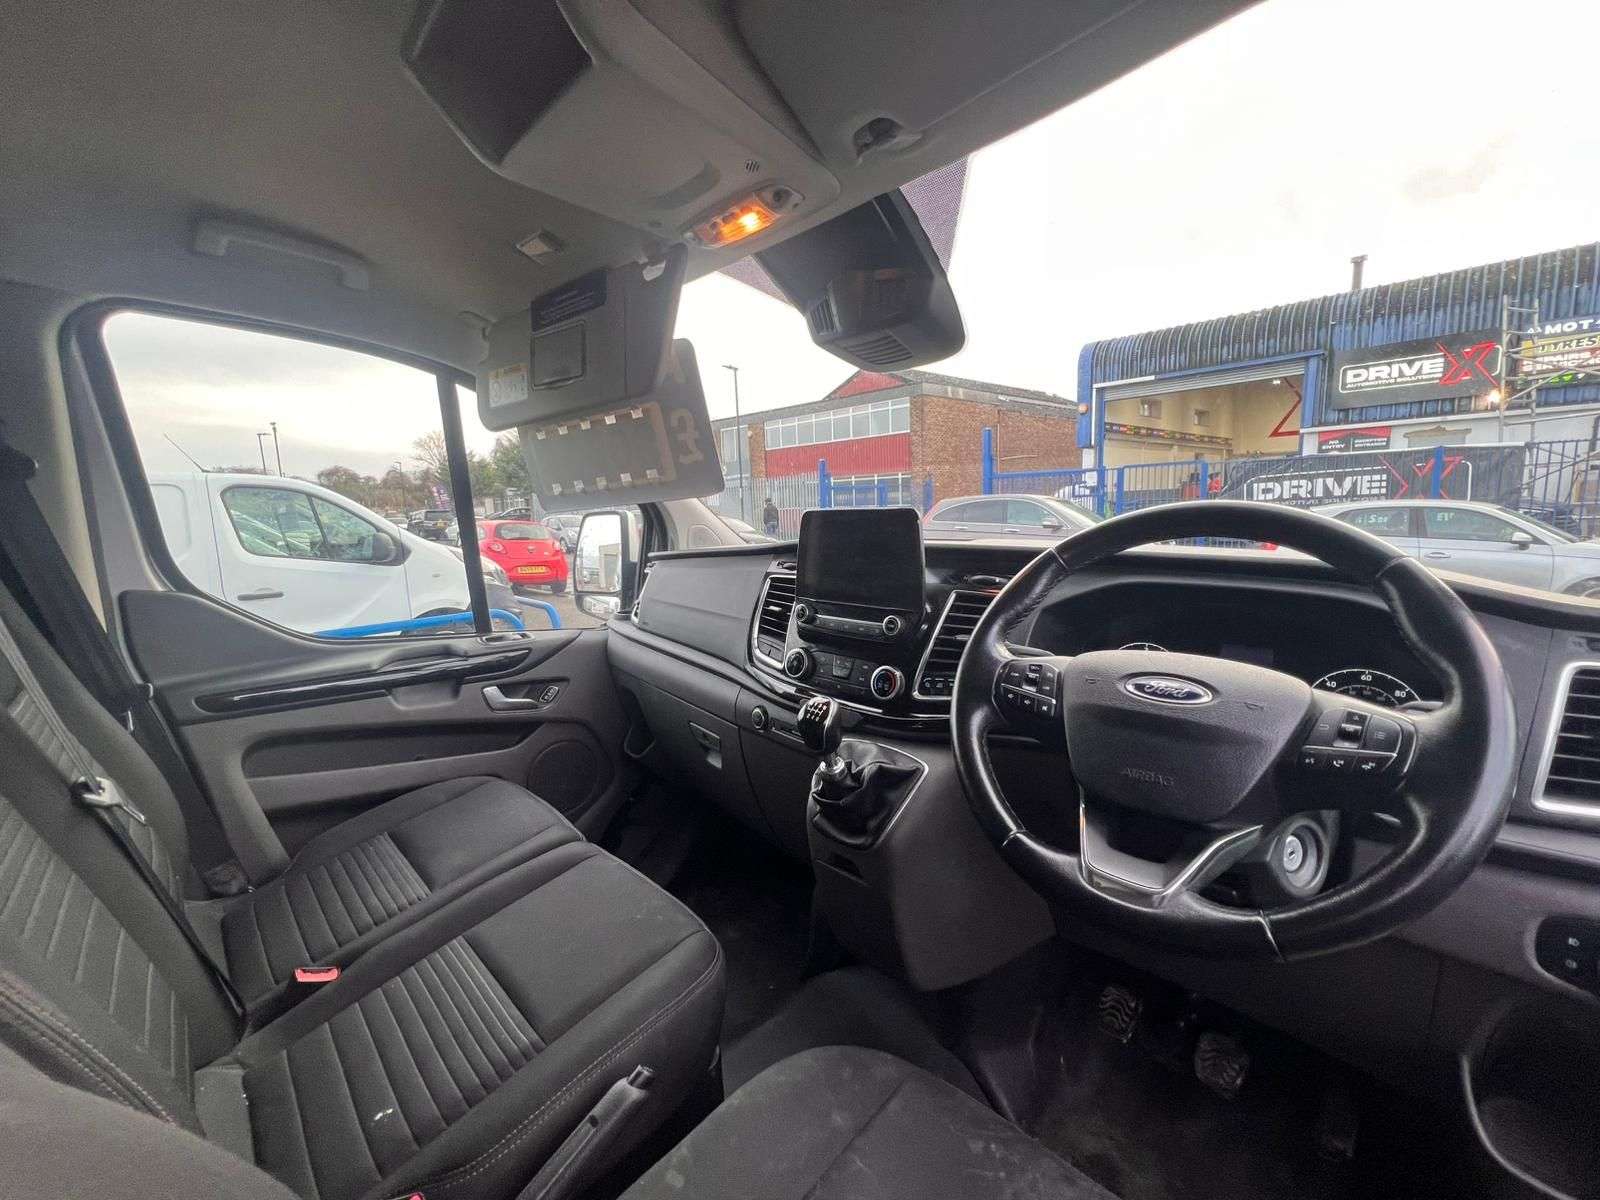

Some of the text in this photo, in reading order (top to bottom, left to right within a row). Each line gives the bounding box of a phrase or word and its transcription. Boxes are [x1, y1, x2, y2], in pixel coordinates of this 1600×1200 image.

[1544, 319, 1594, 335] MOT
[1346, 357, 1444, 384] DRIVE
[1345, 378, 1395, 389] AUTOMOTIVE
[1252, 474, 1388, 500] DRIVE
[1144, 680, 1190, 698] Ford
[1394, 690, 1406, 698] 80
